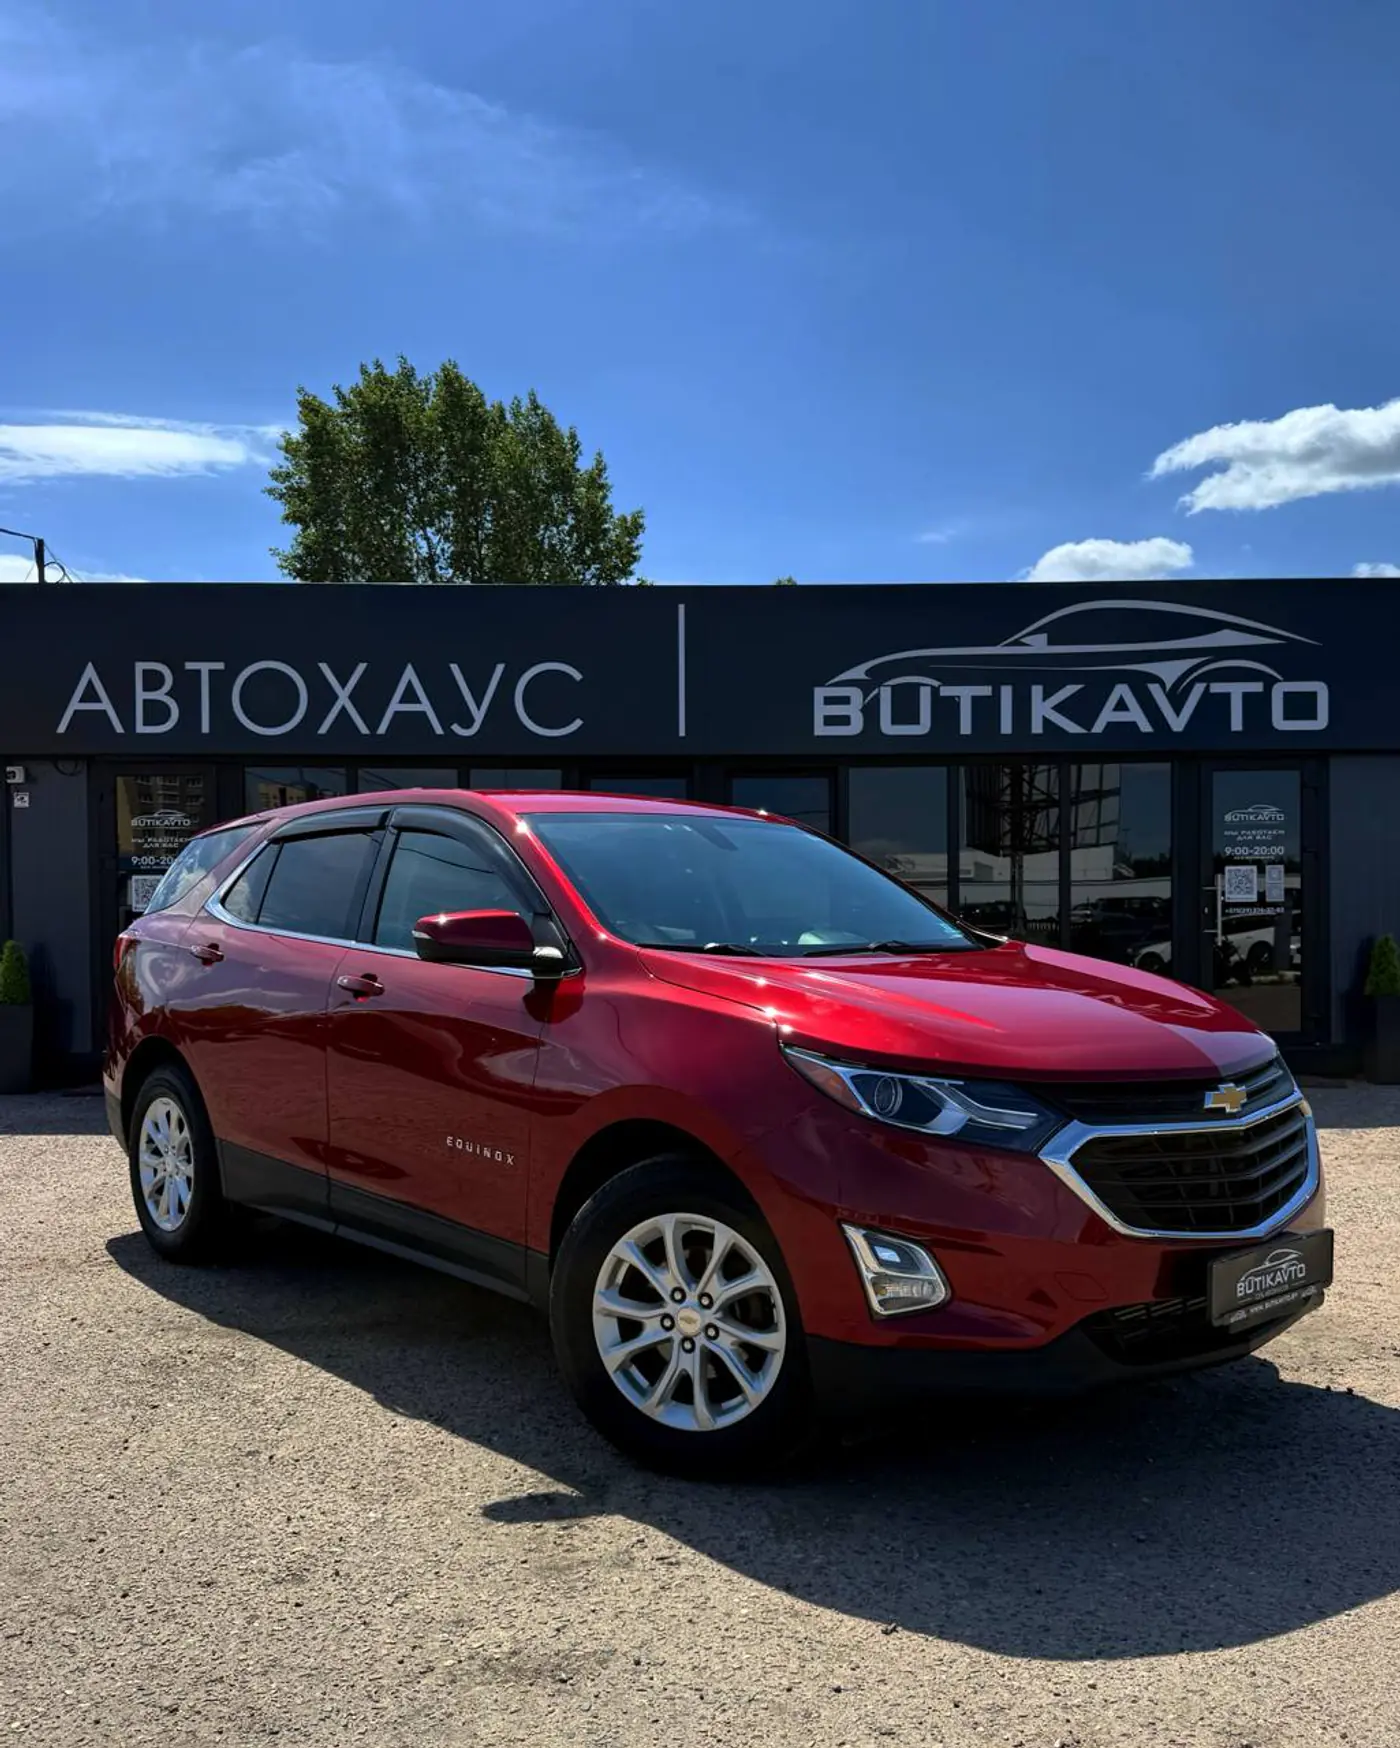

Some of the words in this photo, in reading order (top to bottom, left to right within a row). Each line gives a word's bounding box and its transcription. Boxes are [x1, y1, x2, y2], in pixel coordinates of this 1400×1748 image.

[56, 660, 584, 737] АВТОХАУС
[813, 680, 1330, 736] BUTIKAVTO
[131, 819, 191, 827] BUTIKAVTO
[1224, 813, 1285, 822] BUTIKAVTO
[131, 856, 173, 866] 9:00-20
[1224, 846, 1285, 856] 9:00-20:00
[446, 1136, 515, 1166] EQUINOX
[1236, 1263, 1306, 1297] BUTIKAVTO
